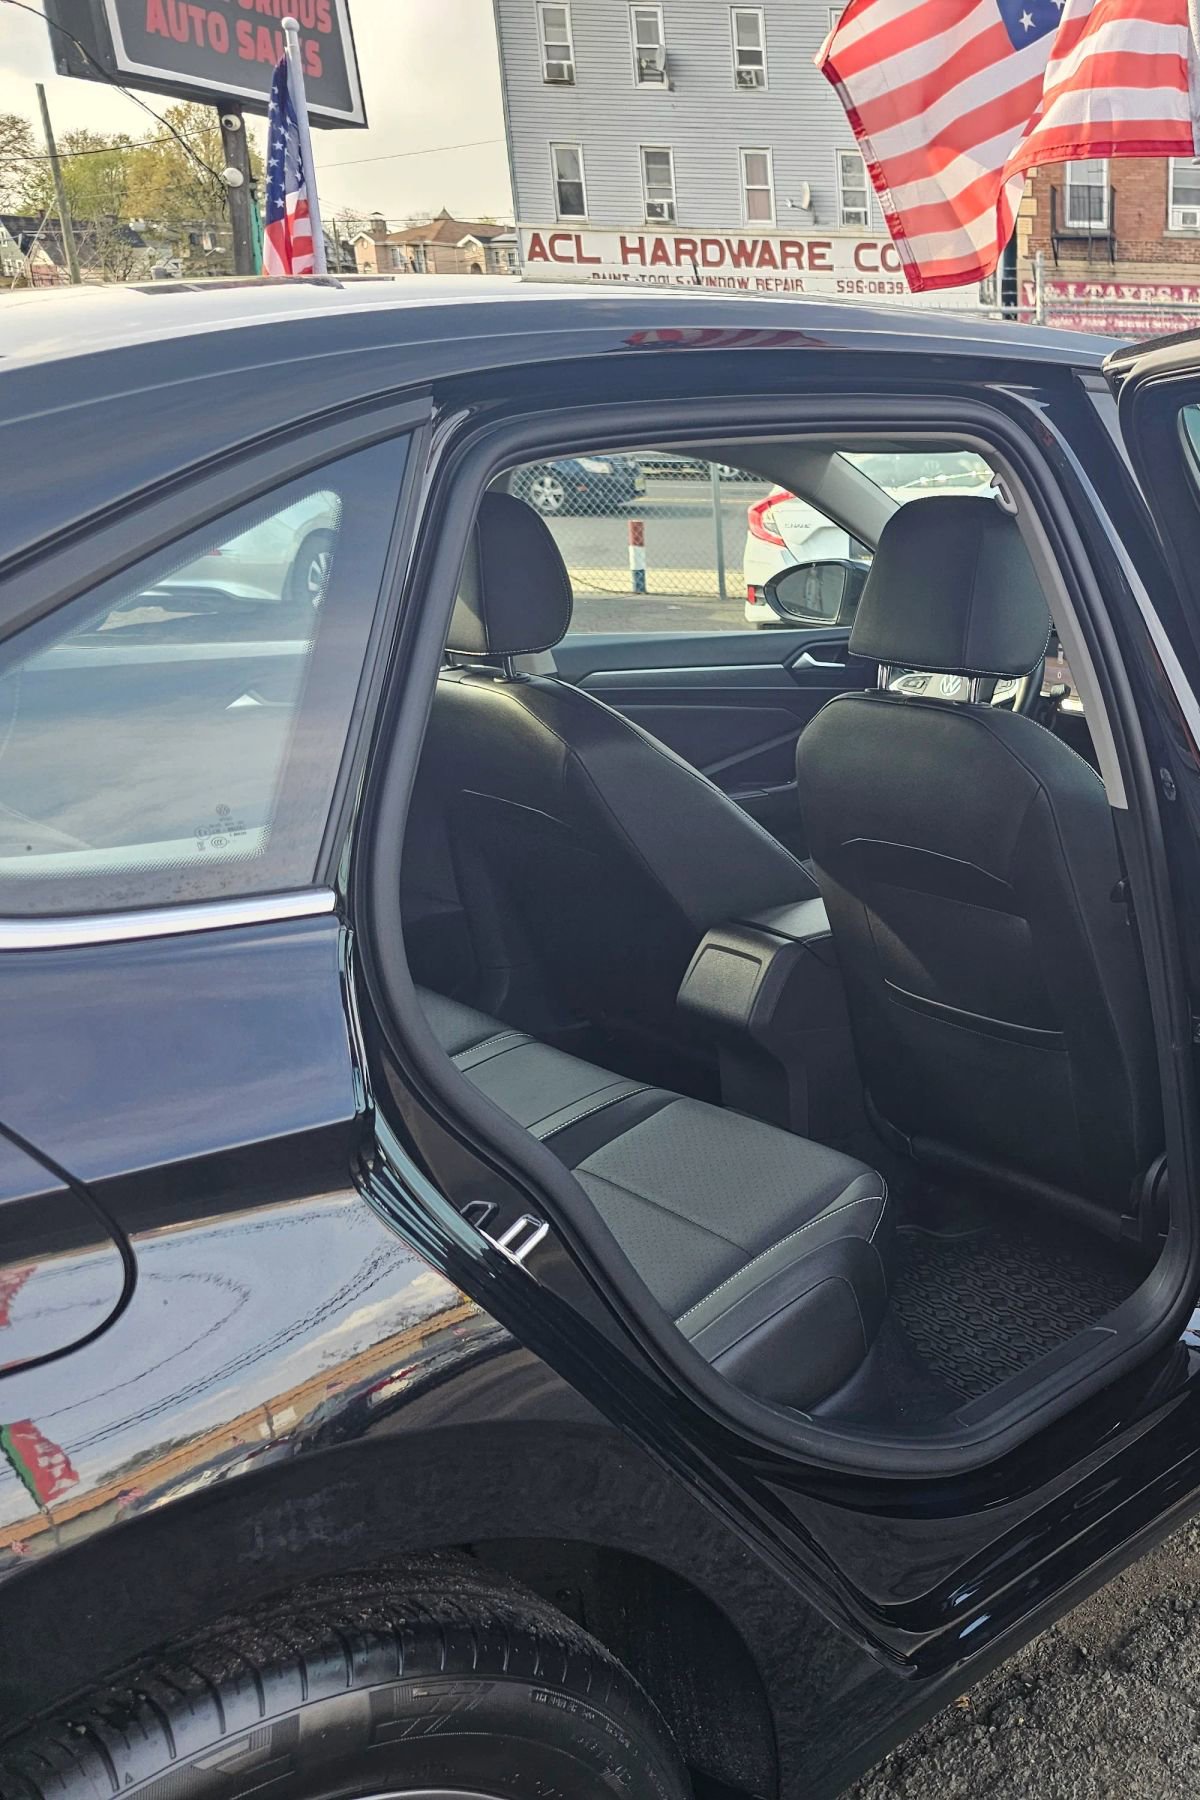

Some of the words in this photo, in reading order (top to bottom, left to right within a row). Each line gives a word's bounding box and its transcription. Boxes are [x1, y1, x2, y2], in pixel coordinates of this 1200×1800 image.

[146, 0, 229, 54] AUTO
[235, 20, 323, 78] SALS
[528, 232, 602, 264] ACL
[619, 235, 834, 271] HARDWARE
[756, 277, 805, 292] REPAIR
